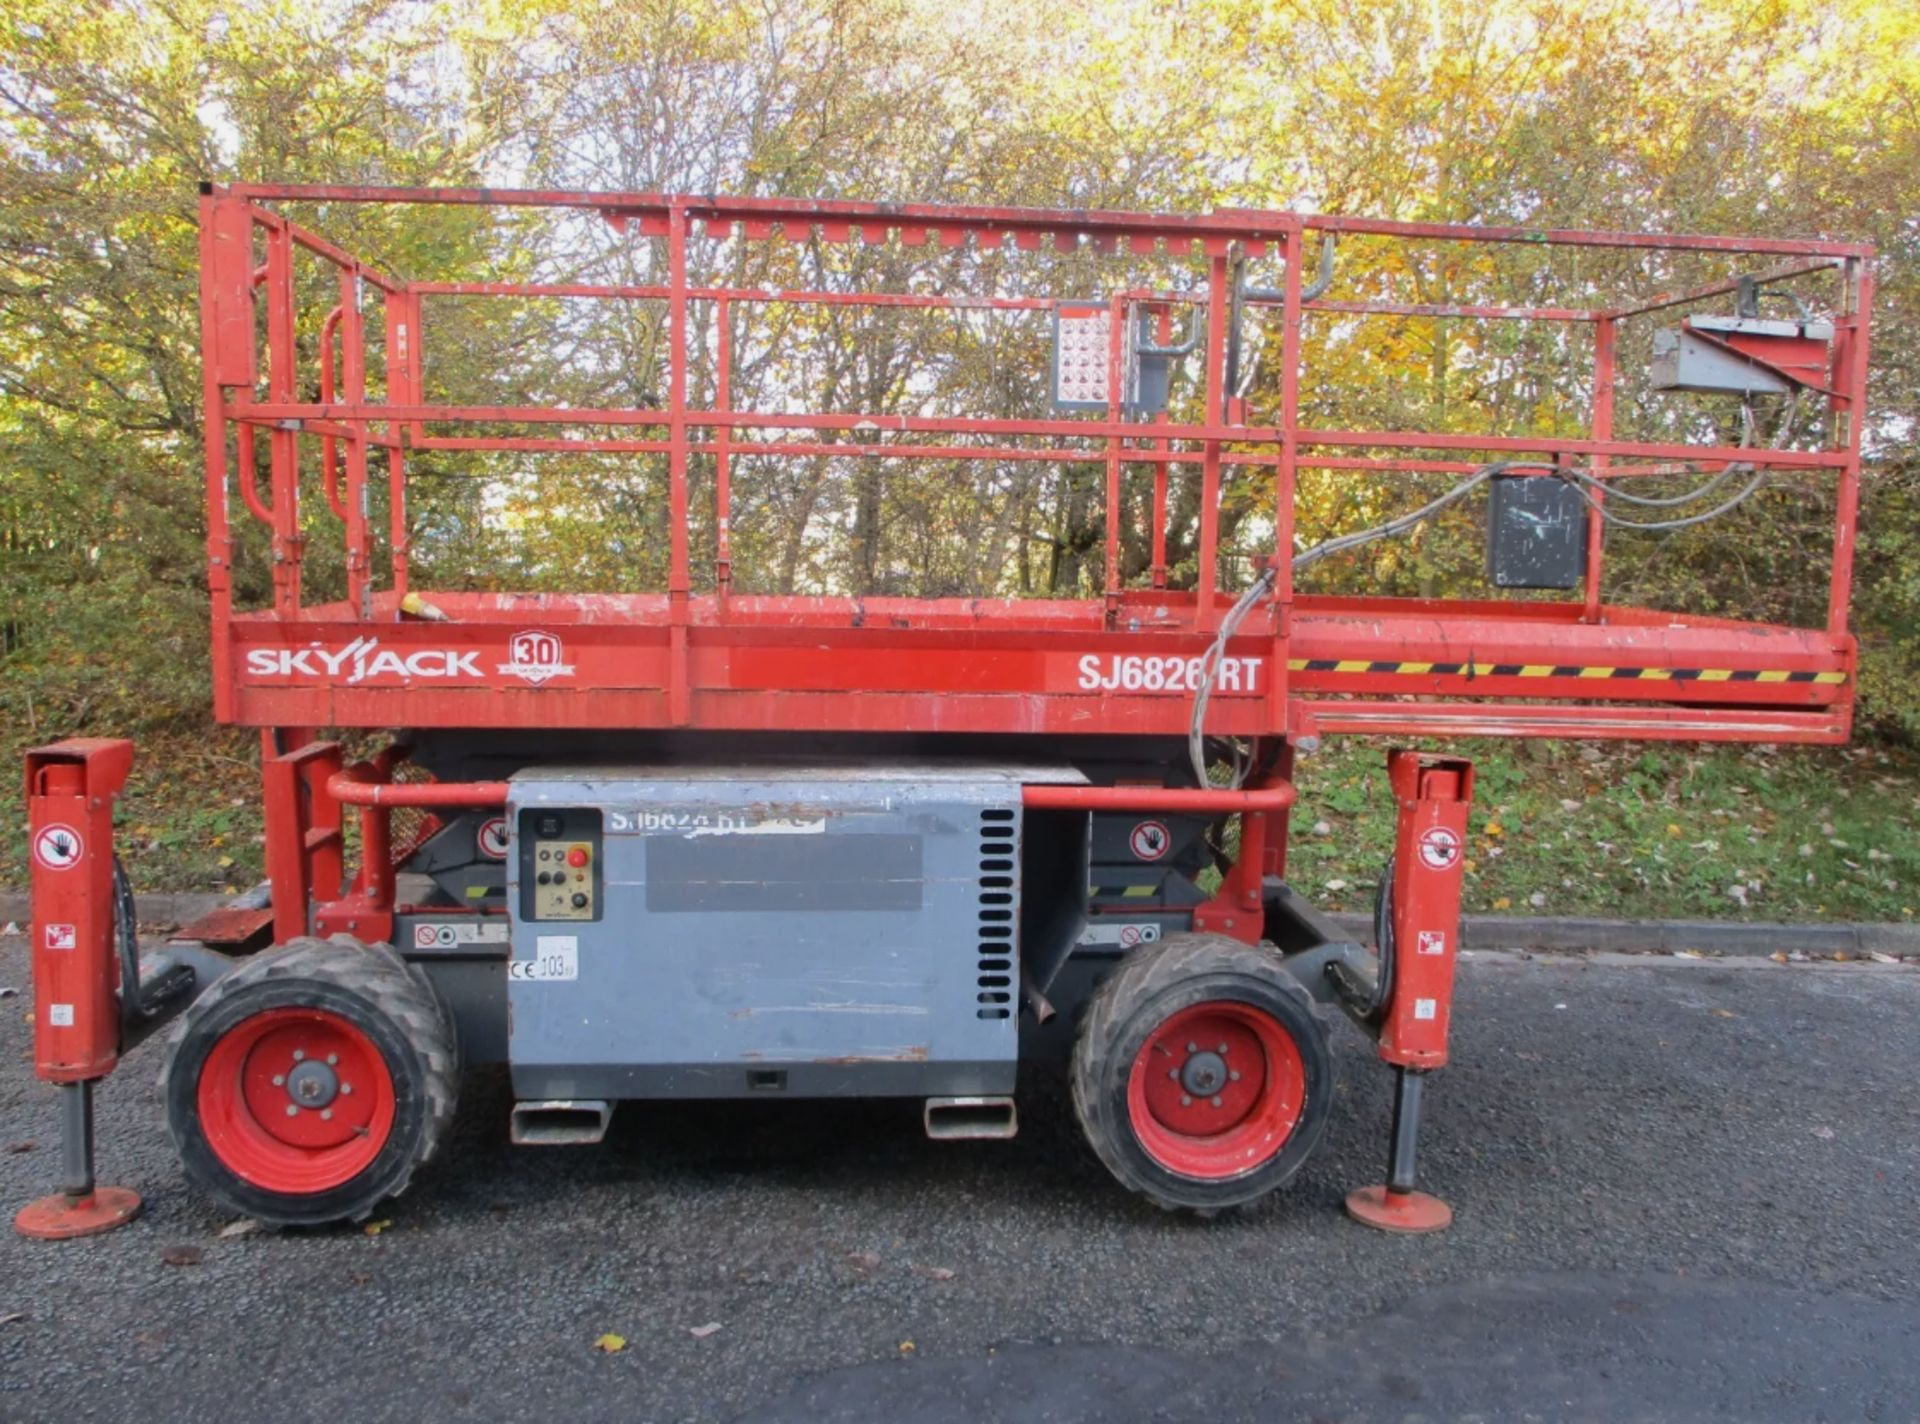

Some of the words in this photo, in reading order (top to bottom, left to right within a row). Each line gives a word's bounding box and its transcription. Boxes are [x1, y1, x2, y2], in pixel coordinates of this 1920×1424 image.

[247, 636, 485, 683] SKYJACK
[518, 638, 554, 664] 30
[1078, 655, 1208, 690] SJ6826
[1217, 657, 1262, 691] RT
